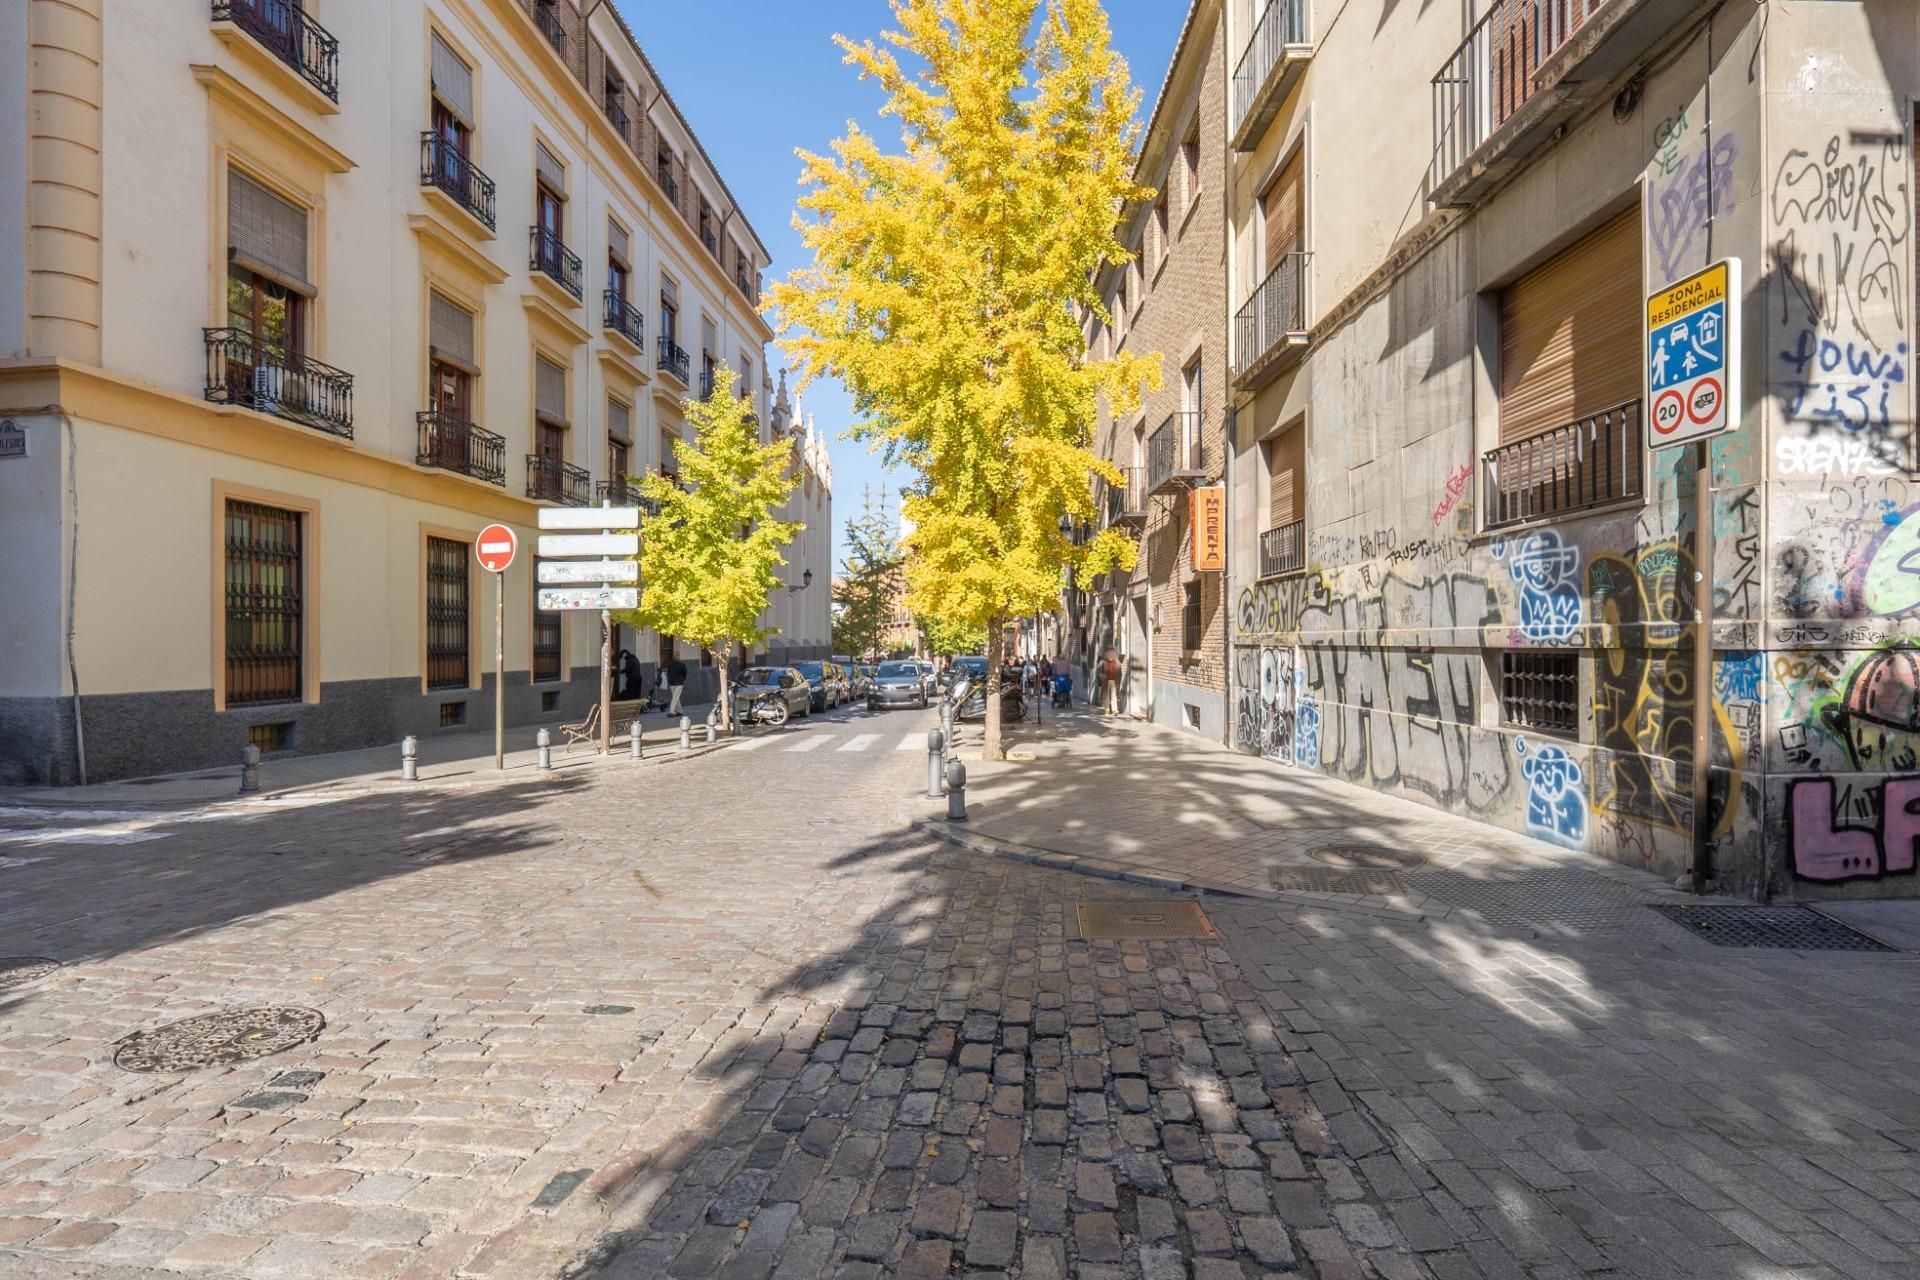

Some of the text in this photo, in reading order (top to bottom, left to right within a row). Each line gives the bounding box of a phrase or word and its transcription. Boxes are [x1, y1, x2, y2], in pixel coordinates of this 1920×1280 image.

[1651, 286, 1722, 326] RESIDENCIAL
[1668, 280, 1703, 305] ZONA
[1659, 403, 1677, 421] 20
[1206, 489, 1219, 560] IMPRENTA
